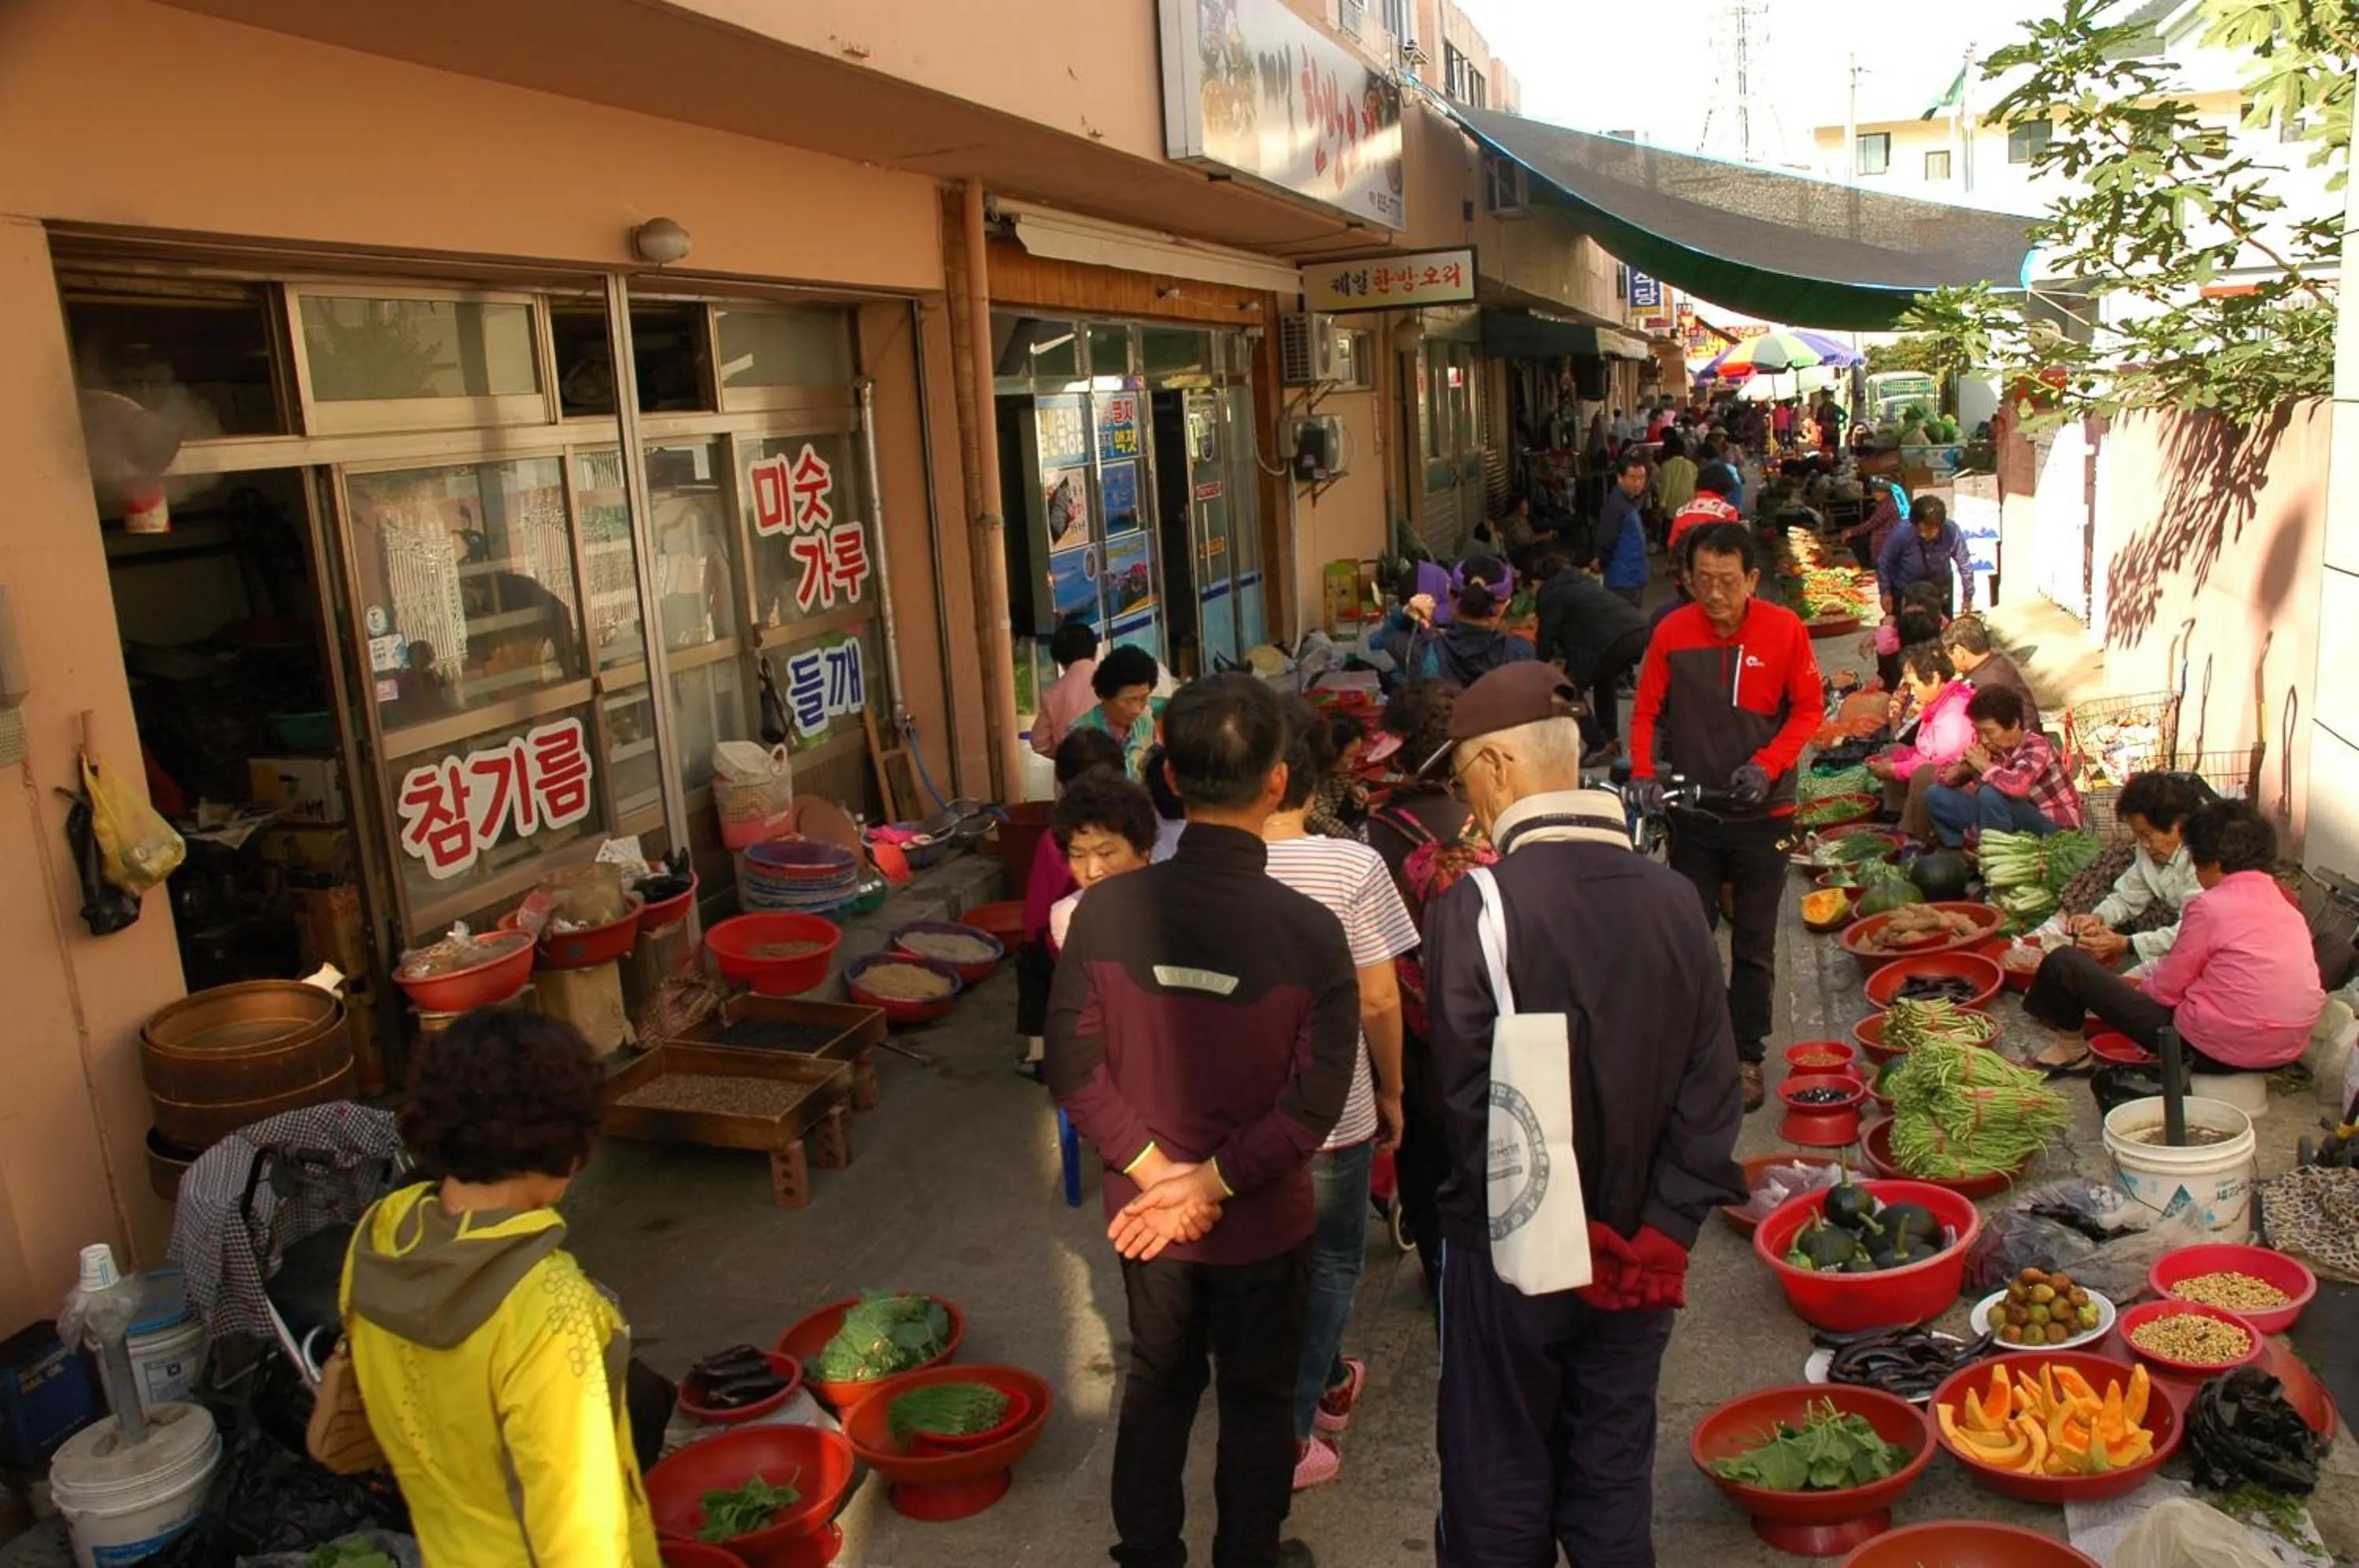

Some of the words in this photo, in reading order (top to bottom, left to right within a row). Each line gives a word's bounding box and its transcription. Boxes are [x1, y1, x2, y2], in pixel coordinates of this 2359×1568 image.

[1330, 270, 1367, 296] 제일
[749, 450, 832, 532] 미숫
[794, 527, 868, 608] 가루
[789, 642, 863, 731] 들깨
[402, 723, 590, 870] 참기름
